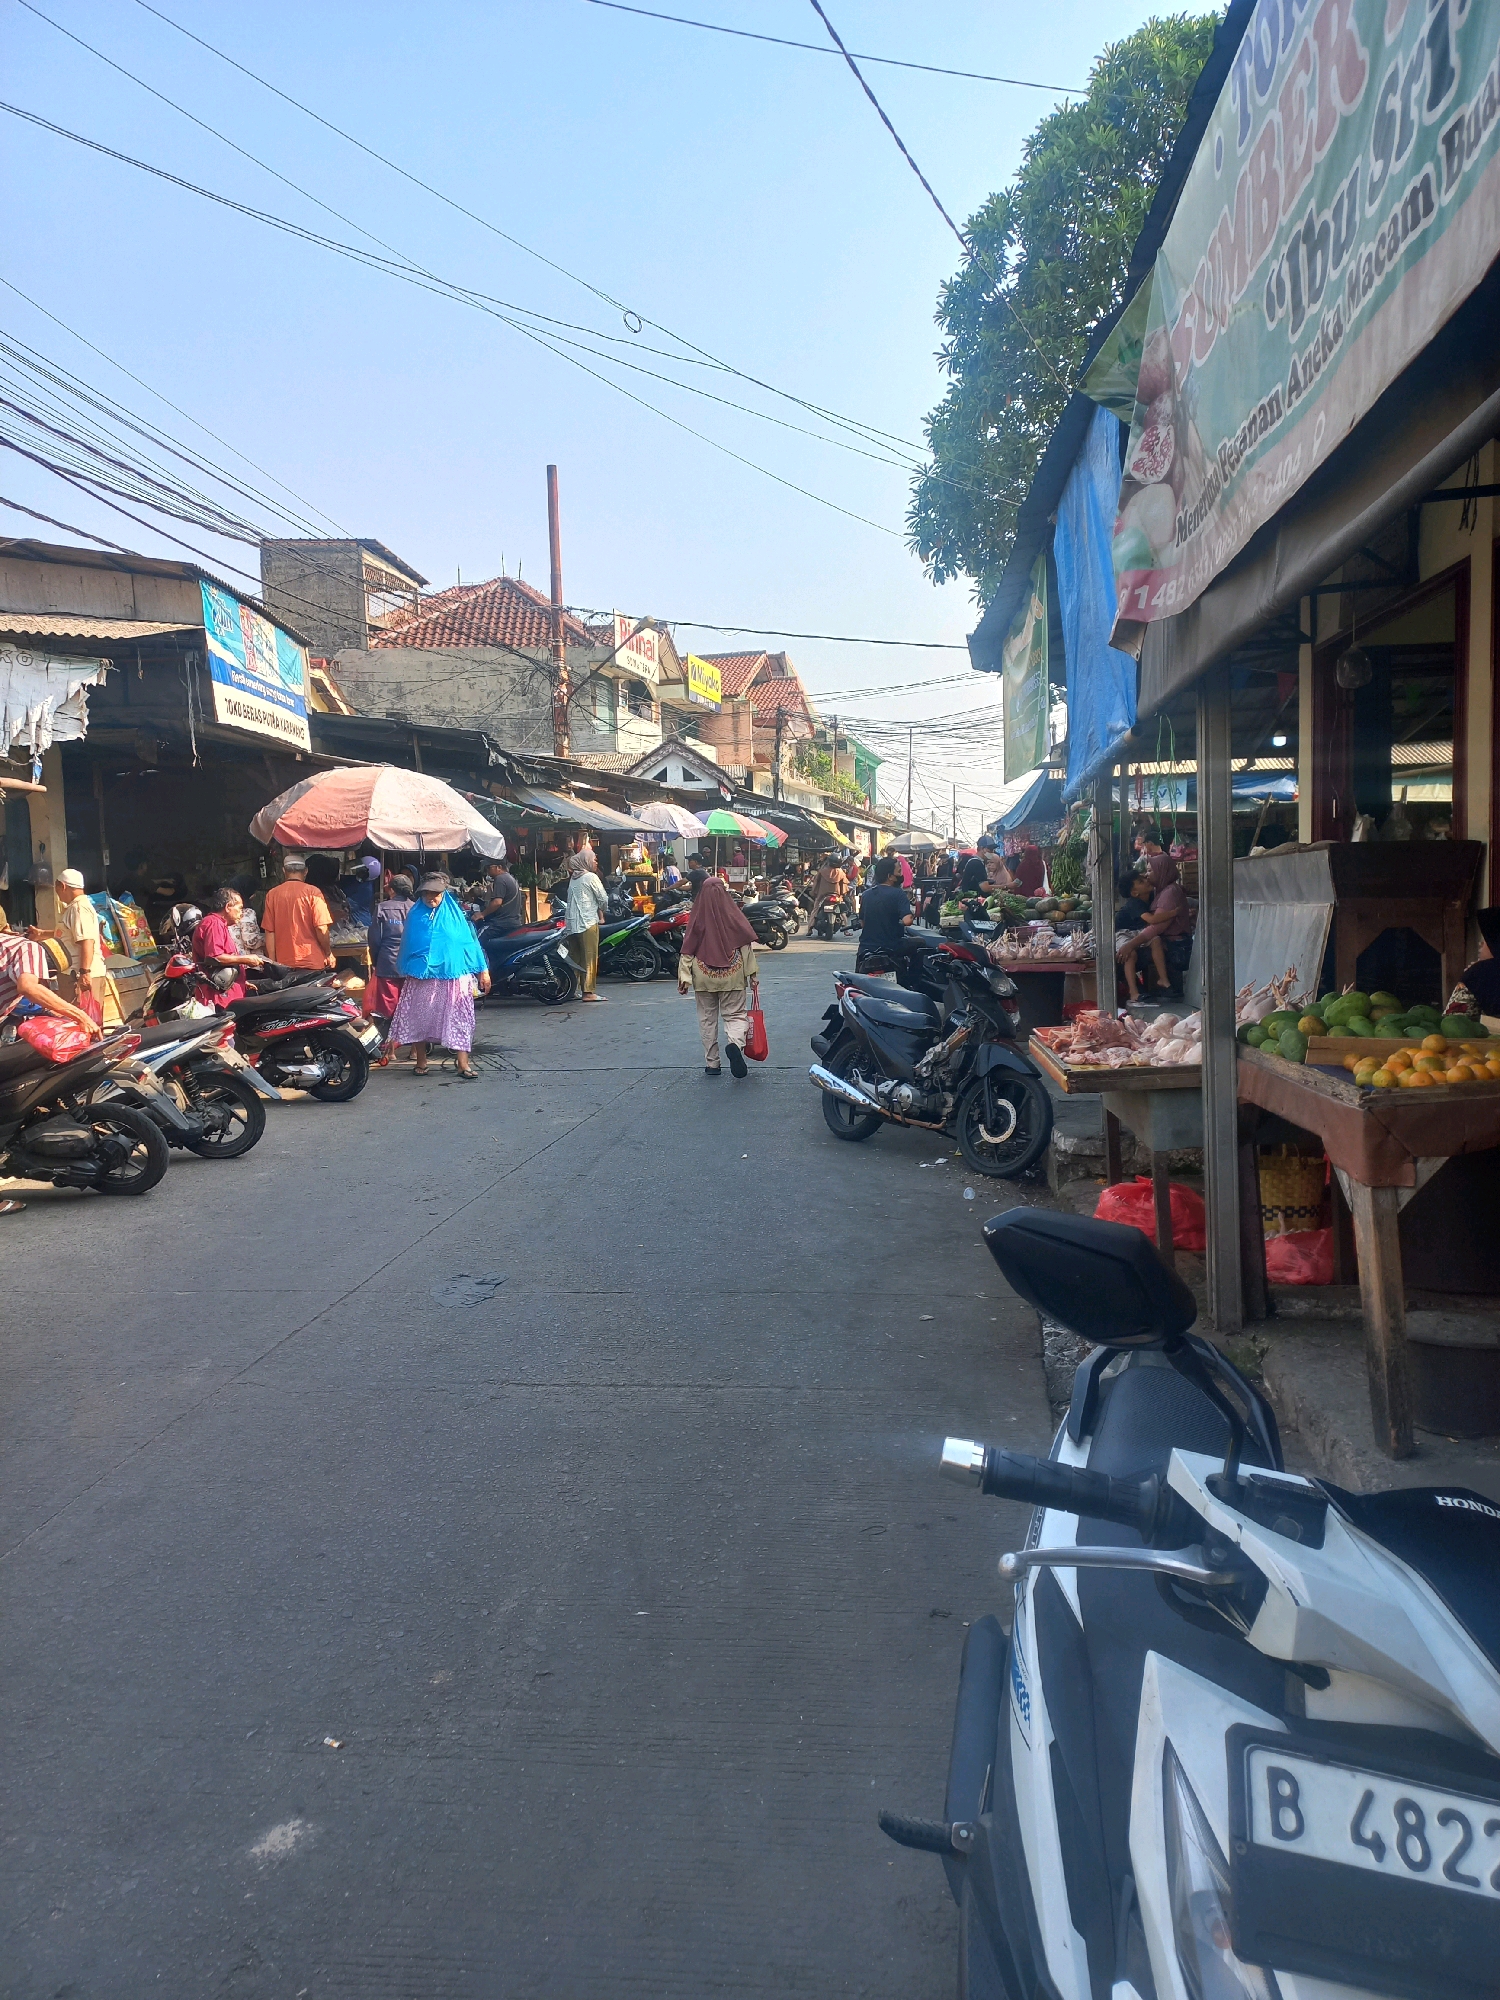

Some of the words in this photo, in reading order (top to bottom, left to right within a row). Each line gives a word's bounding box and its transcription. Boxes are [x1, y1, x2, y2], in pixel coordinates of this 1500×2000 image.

[1176, 467, 1221, 548] Menerima
[1218, 387, 1283, 481] Pesanan
[1287, 302, 1344, 408] Aneka
[1347, 172, 1435, 325] Macam
[1442, 45, 1500, 196] Bua
[619, 618, 656, 663] Rinnai
[225, 698, 242, 717] TOKO
[243, 704, 262, 724] BERAS
[1266, 1765, 1305, 1842] B
